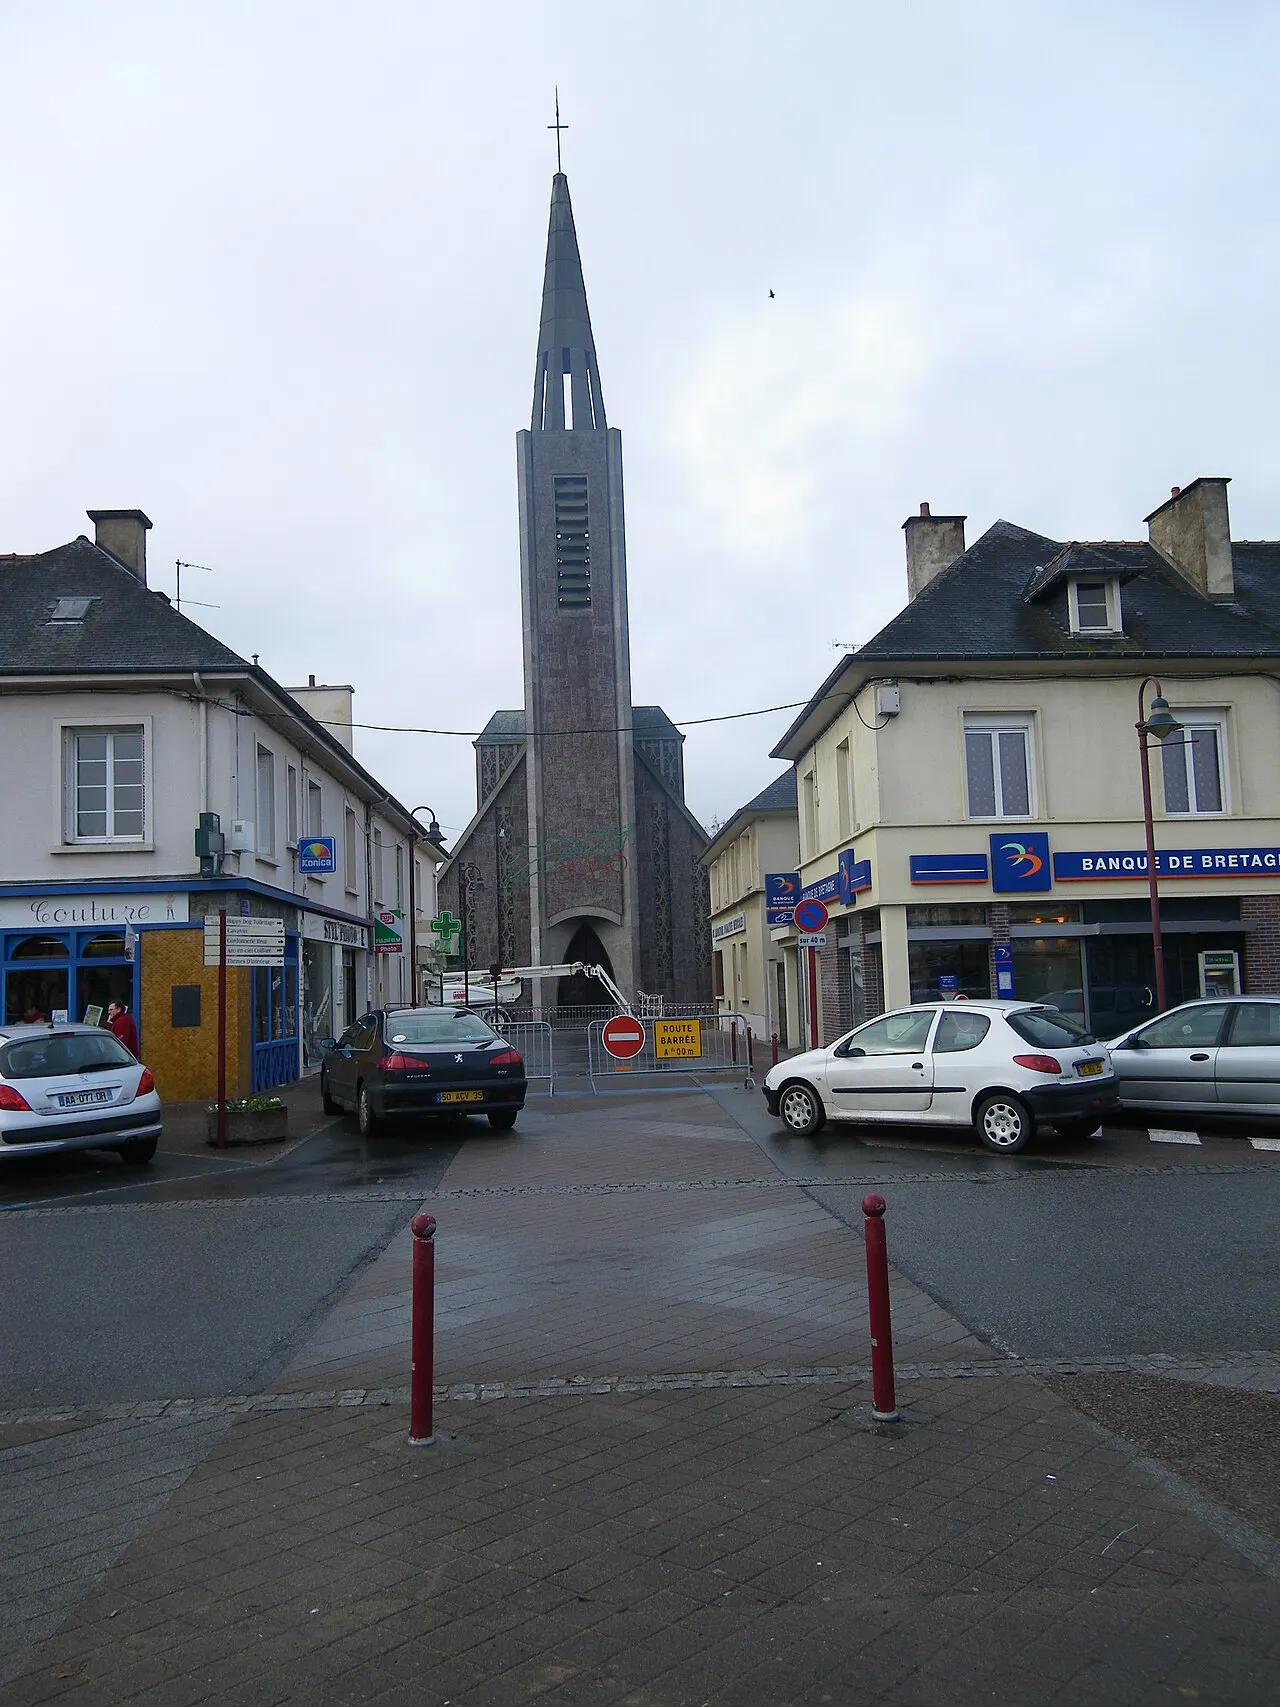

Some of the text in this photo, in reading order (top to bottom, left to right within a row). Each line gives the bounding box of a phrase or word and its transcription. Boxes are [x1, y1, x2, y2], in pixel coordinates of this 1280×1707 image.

[302, 858, 331, 867] Konica
[1082, 853, 1280, 871] BANQUE DE BRETAG
[30, 900, 151, 923] Couture
[663, 1024, 692, 1033] ROUTE
[660, 1034, 696, 1044] BARRÉE
[65, 1091, 107, 1105] AA-077-DR
[456, 1092, 469, 1100] ACV
[473, 1091, 482, 1100] 35
